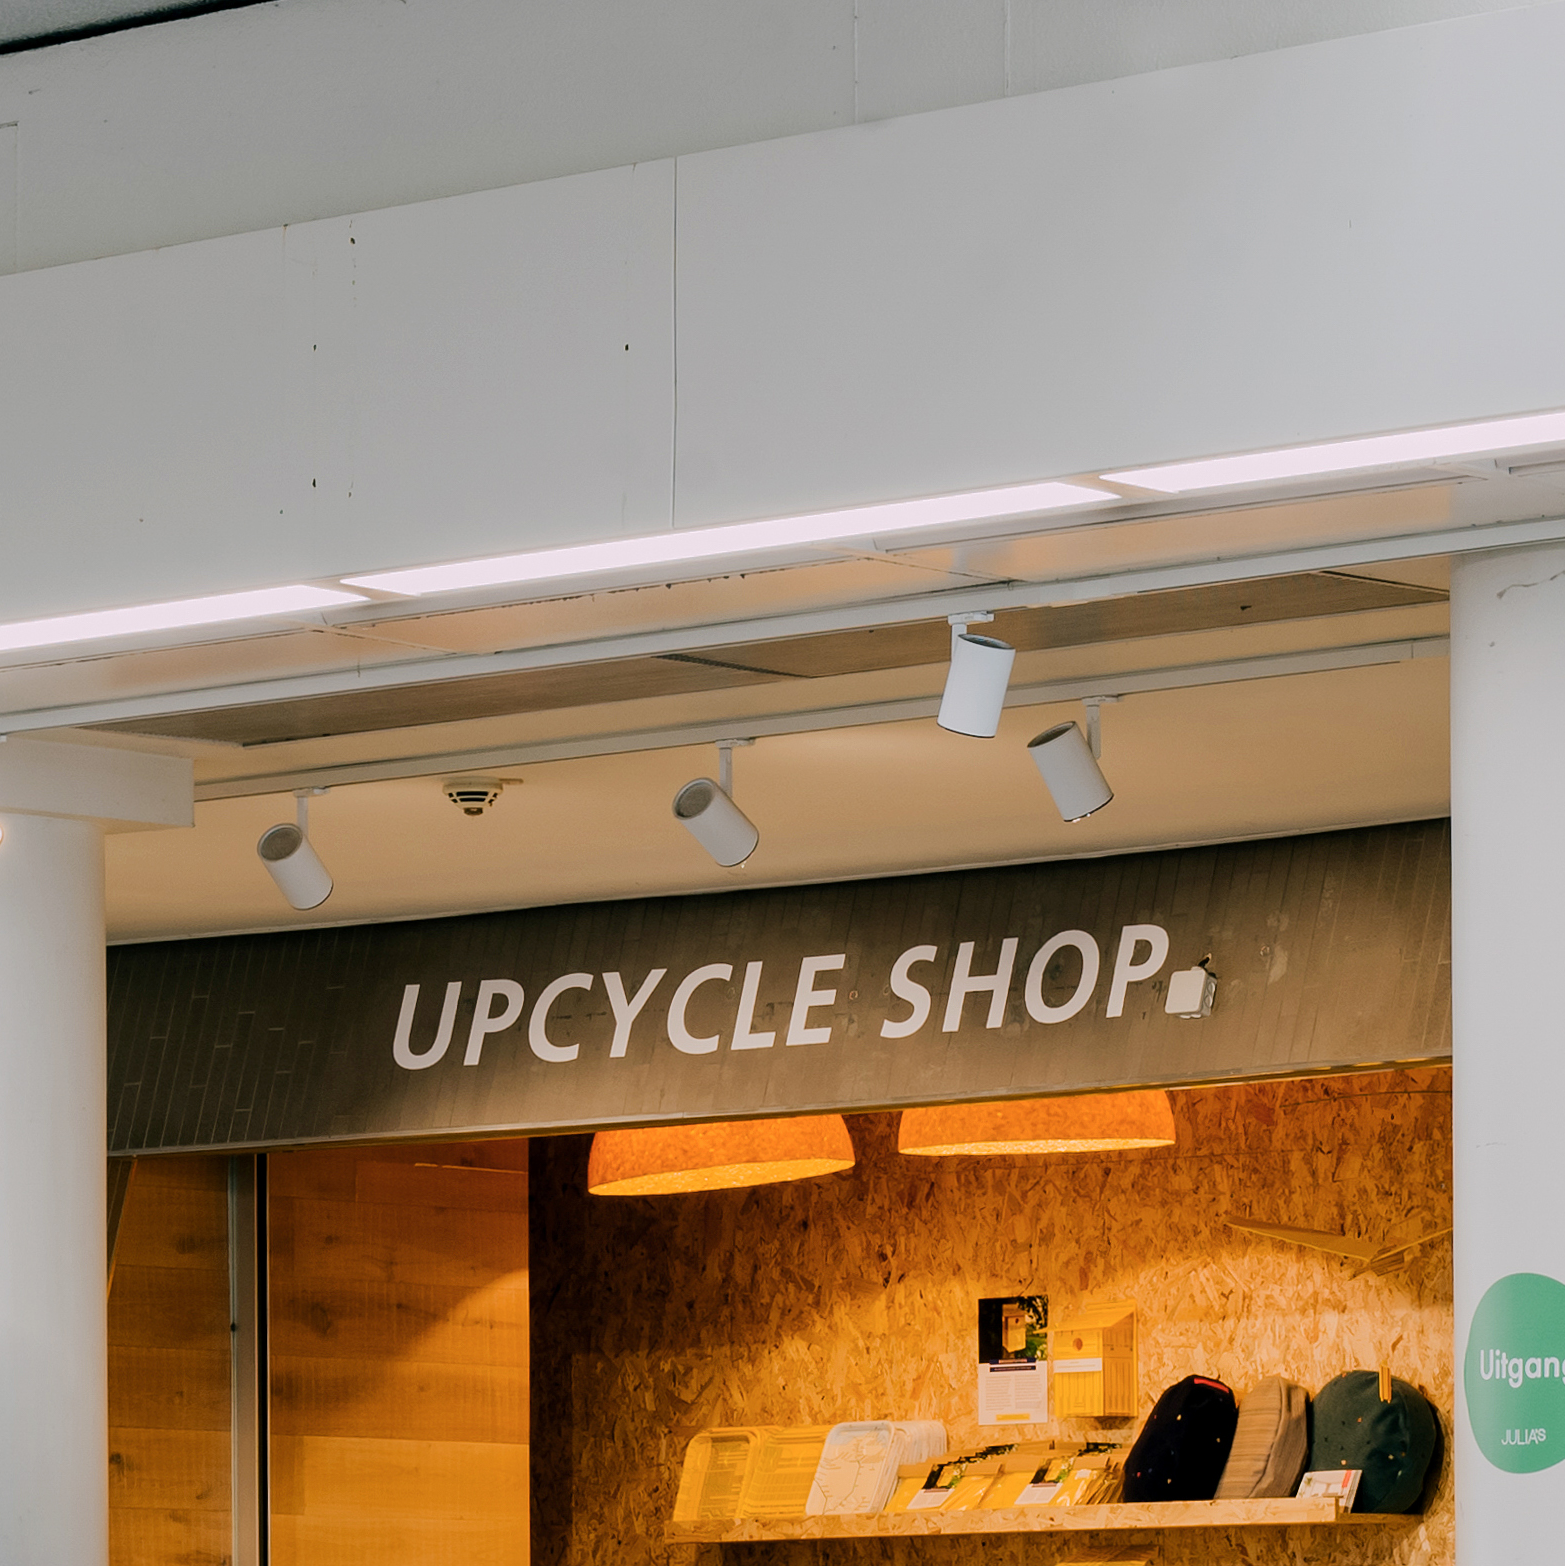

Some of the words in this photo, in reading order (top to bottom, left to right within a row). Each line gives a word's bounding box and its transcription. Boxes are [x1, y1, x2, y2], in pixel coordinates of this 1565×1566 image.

[392, 953, 847, 1071] UPCYCLE
[880, 923, 1170, 1039] SHOP
[1501, 1428, 1547, 1446] JULIA'S
